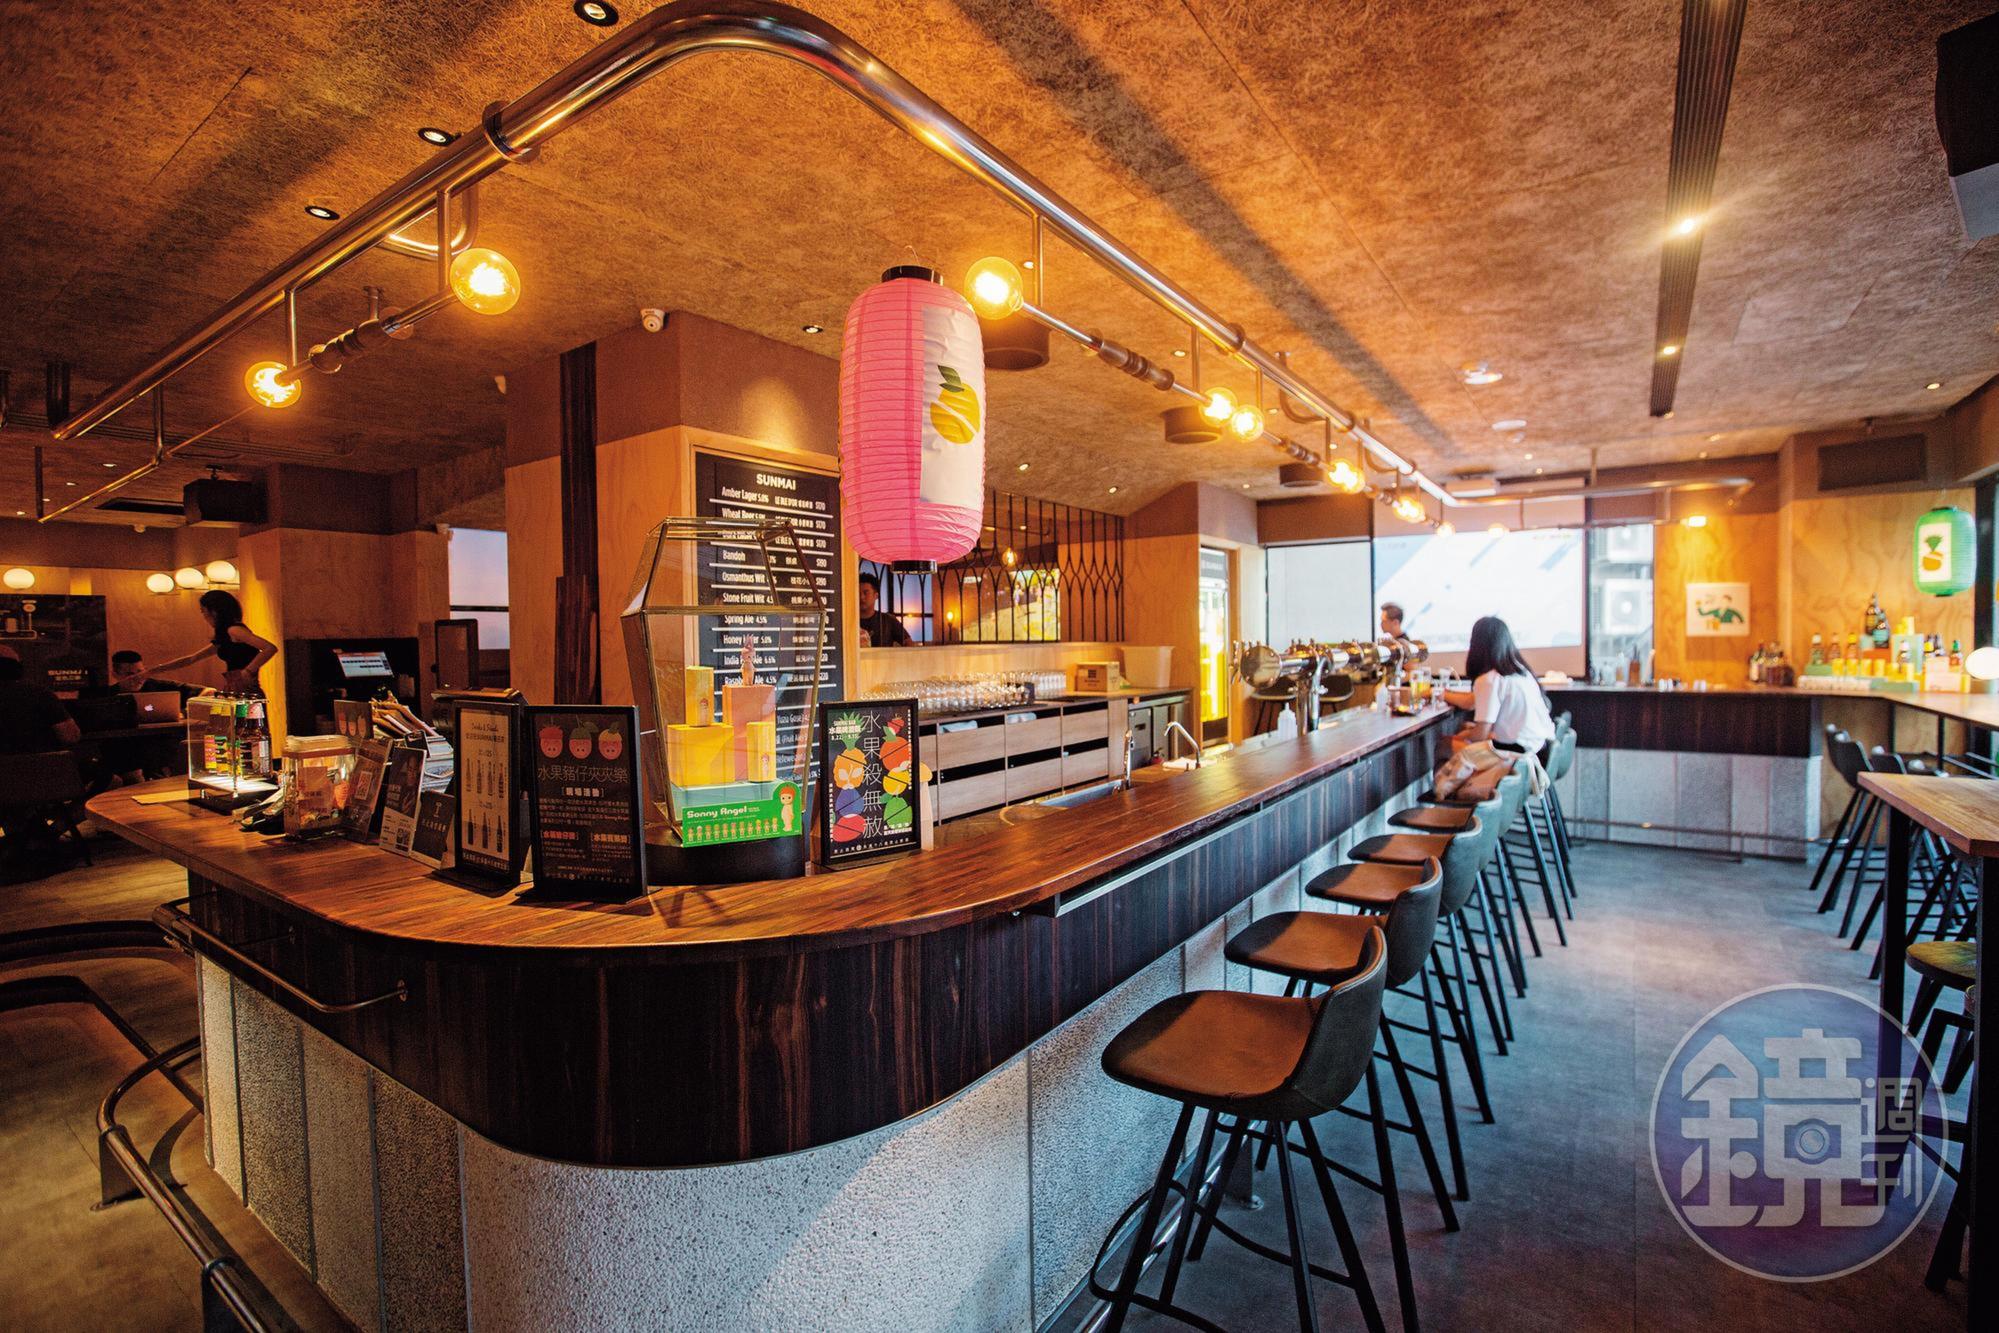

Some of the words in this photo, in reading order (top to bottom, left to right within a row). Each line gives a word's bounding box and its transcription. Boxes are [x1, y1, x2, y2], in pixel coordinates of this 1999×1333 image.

[756, 474, 796, 490] SUNMAI
[722, 486, 740, 498] Amber
[742, 489, 757, 502] Lager
[722, 572, 754, 583] Osmanthus
[723, 593, 740, 603] Stone
[741, 593, 754, 603] Fruit
[725, 615, 744, 624] Spring
[724, 635, 742, 645] Honey
[724, 655, 739, 665] India
[862, 710, 883, 839] 水果殺無赦
[686, 809, 718, 819] Sonny
[720, 806, 747, 816] Angel
